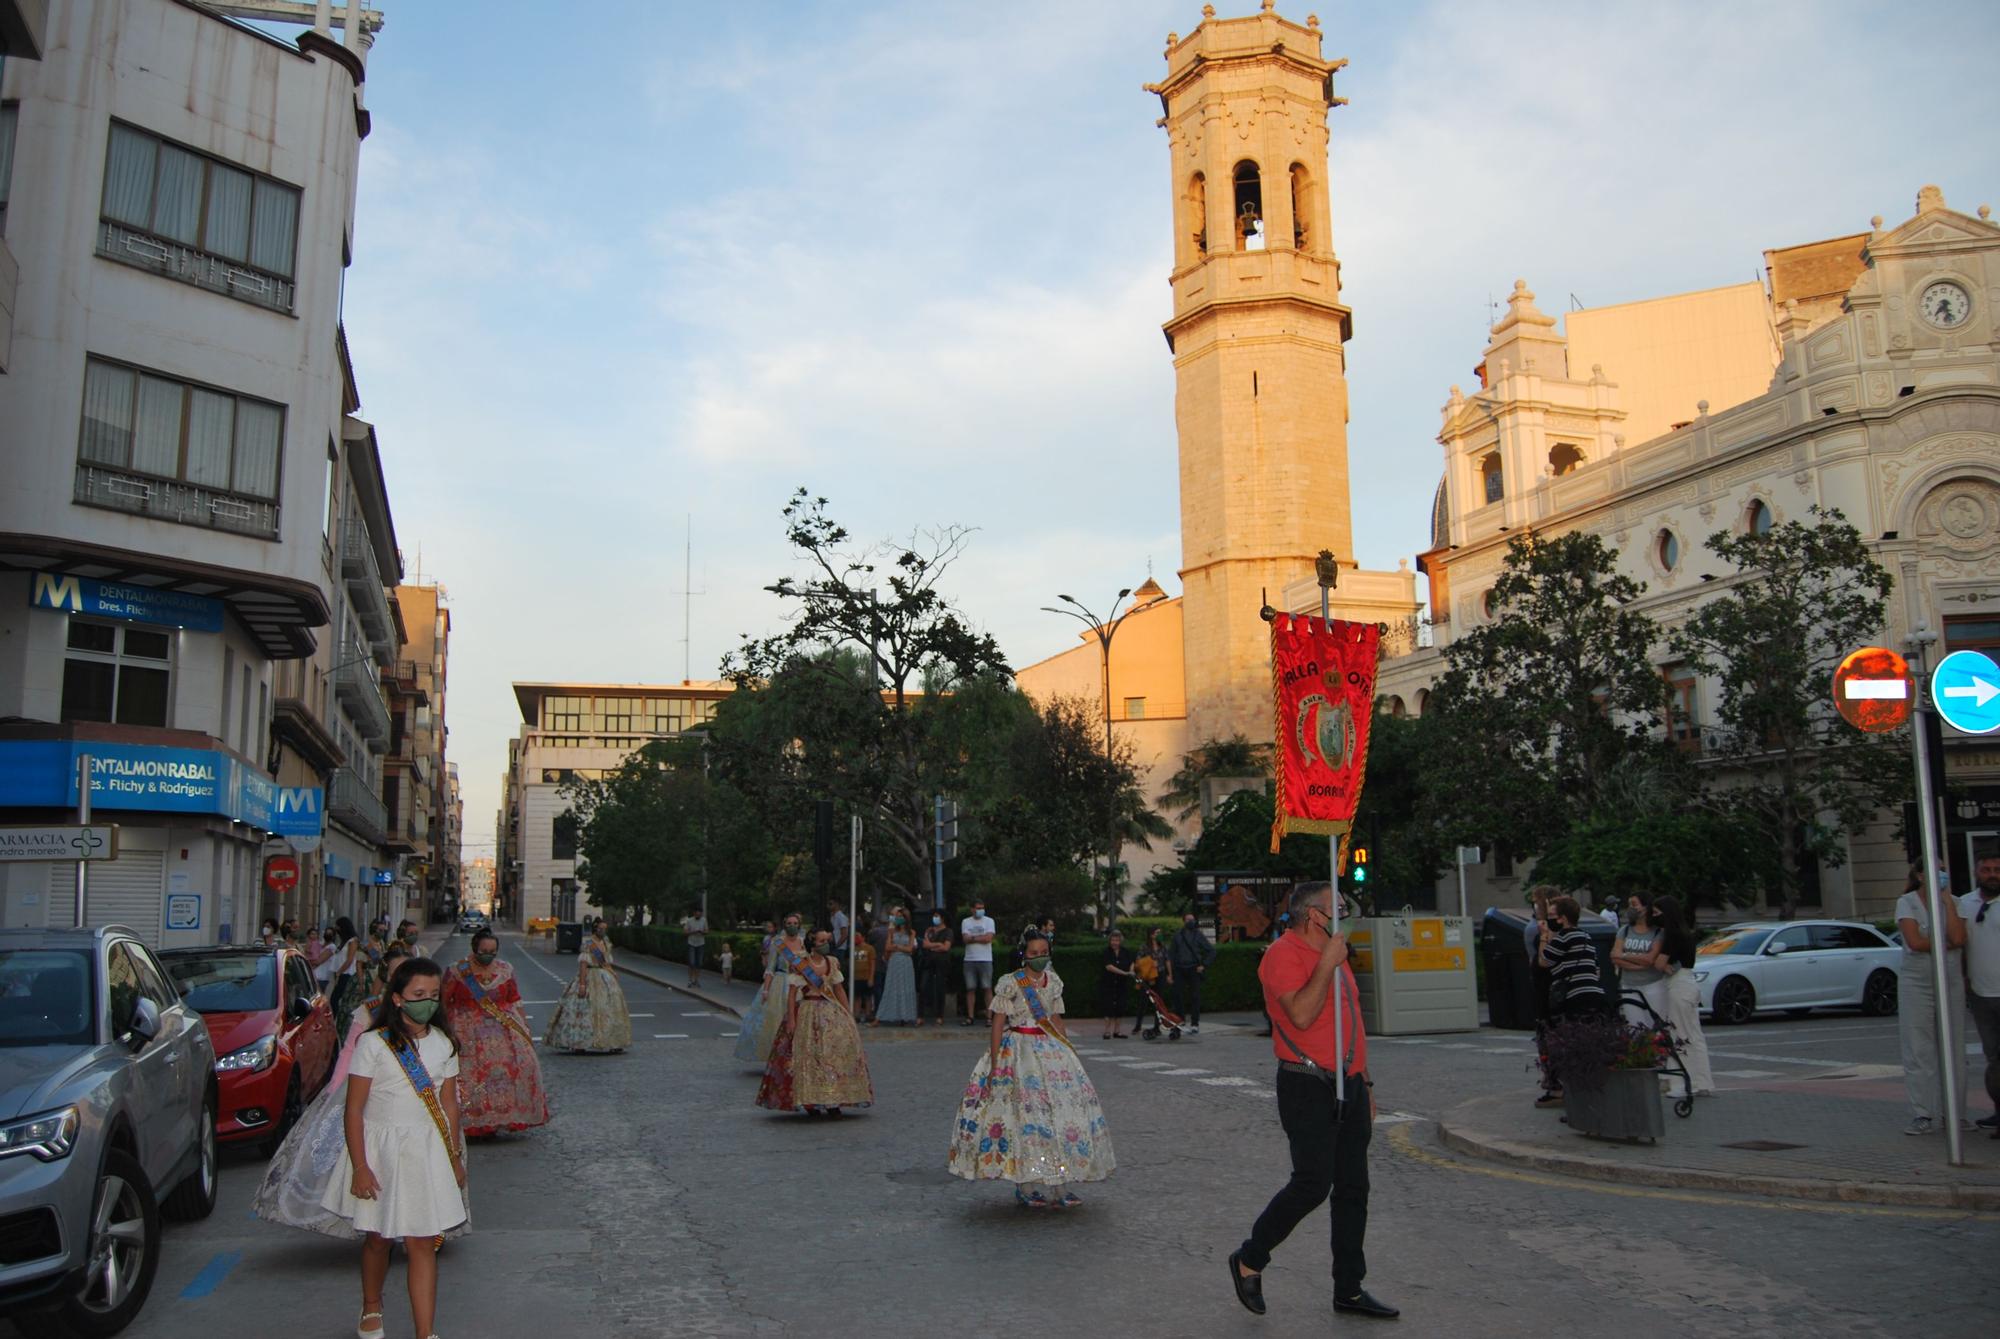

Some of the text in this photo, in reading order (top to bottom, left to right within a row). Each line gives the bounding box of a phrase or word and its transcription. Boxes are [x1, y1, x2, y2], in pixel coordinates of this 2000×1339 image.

[35, 573, 83, 611] M
[98, 600, 124, 613] Dres.
[75, 777, 214, 797] es. Flichy & Rodríguez
[279, 788, 317, 813] M
[27, 847, 67, 856] moreno
[1625, 937, 1652, 951] ODAY
